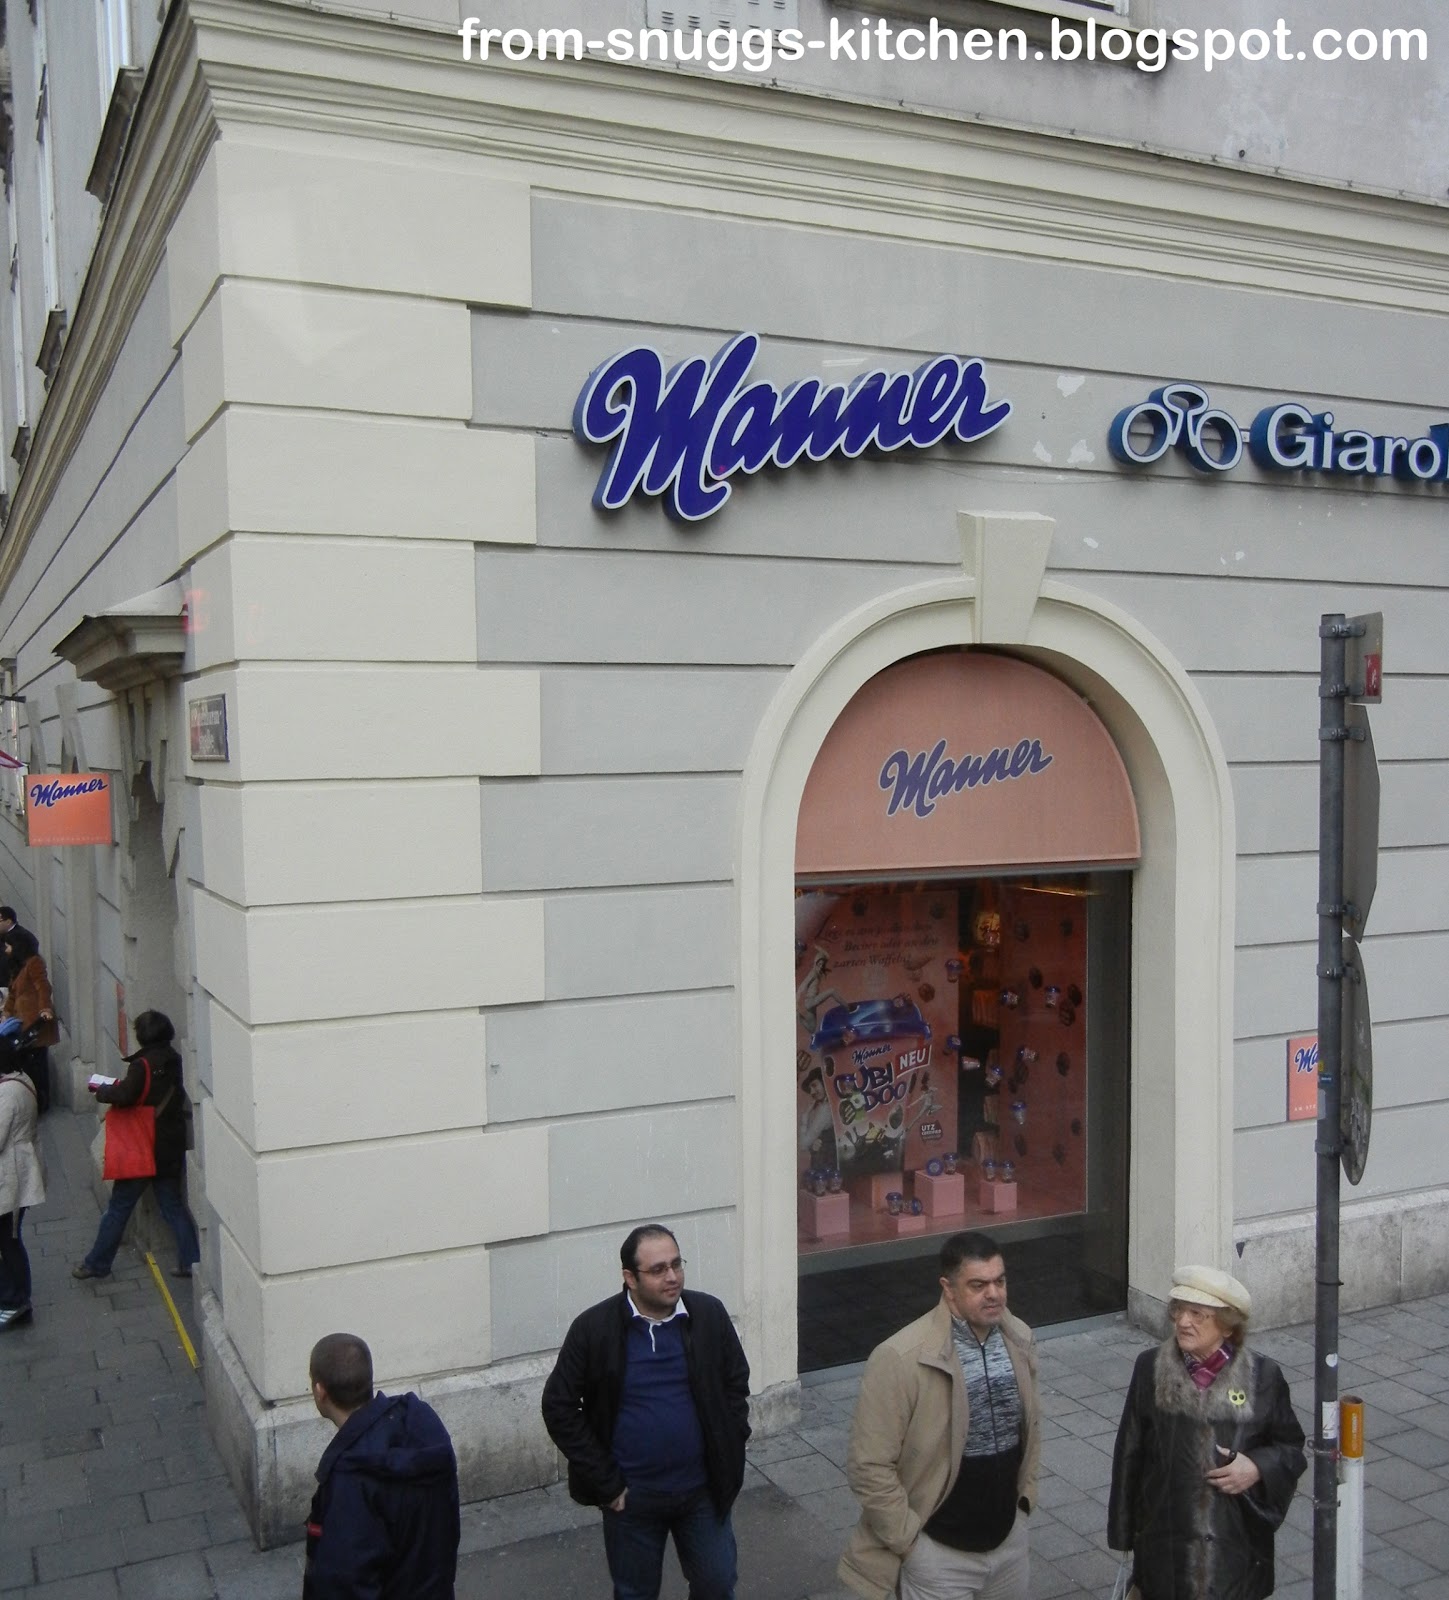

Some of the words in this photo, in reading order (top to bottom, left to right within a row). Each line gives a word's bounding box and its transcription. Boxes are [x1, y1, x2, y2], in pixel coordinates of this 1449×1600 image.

[578, 331, 1013, 521] Manner
[1262, 402, 1449, 480] Giaro
[29, 778, 108, 807] Manner
[878, 738, 1053, 818] Manner
[899, 1047, 927, 1070] NEU
[862, 1081, 909, 1112] DOO
[921, 1124, 935, 1132] UTZ
